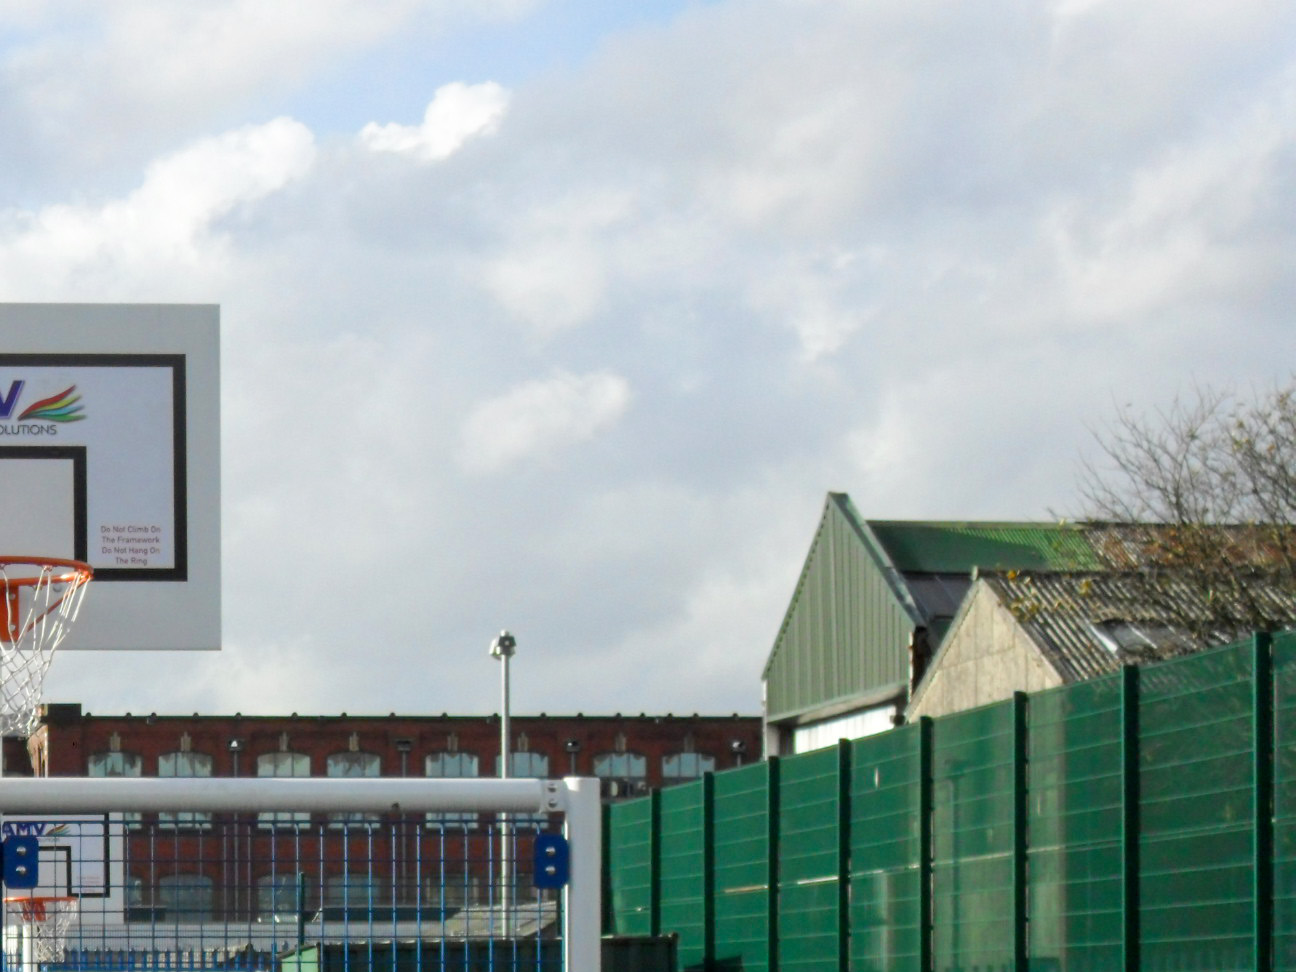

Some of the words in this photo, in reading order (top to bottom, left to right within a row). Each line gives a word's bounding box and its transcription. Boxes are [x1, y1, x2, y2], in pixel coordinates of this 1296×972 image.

[100, 525, 111, 533] Do
[113, 525, 126, 533] Not
[127, 525, 149, 533] Climb
[151, 525, 161, 533] On
[129, 547, 148, 556] Hang
[116, 557, 129, 565] The
[131, 557, 148, 566] Ring
